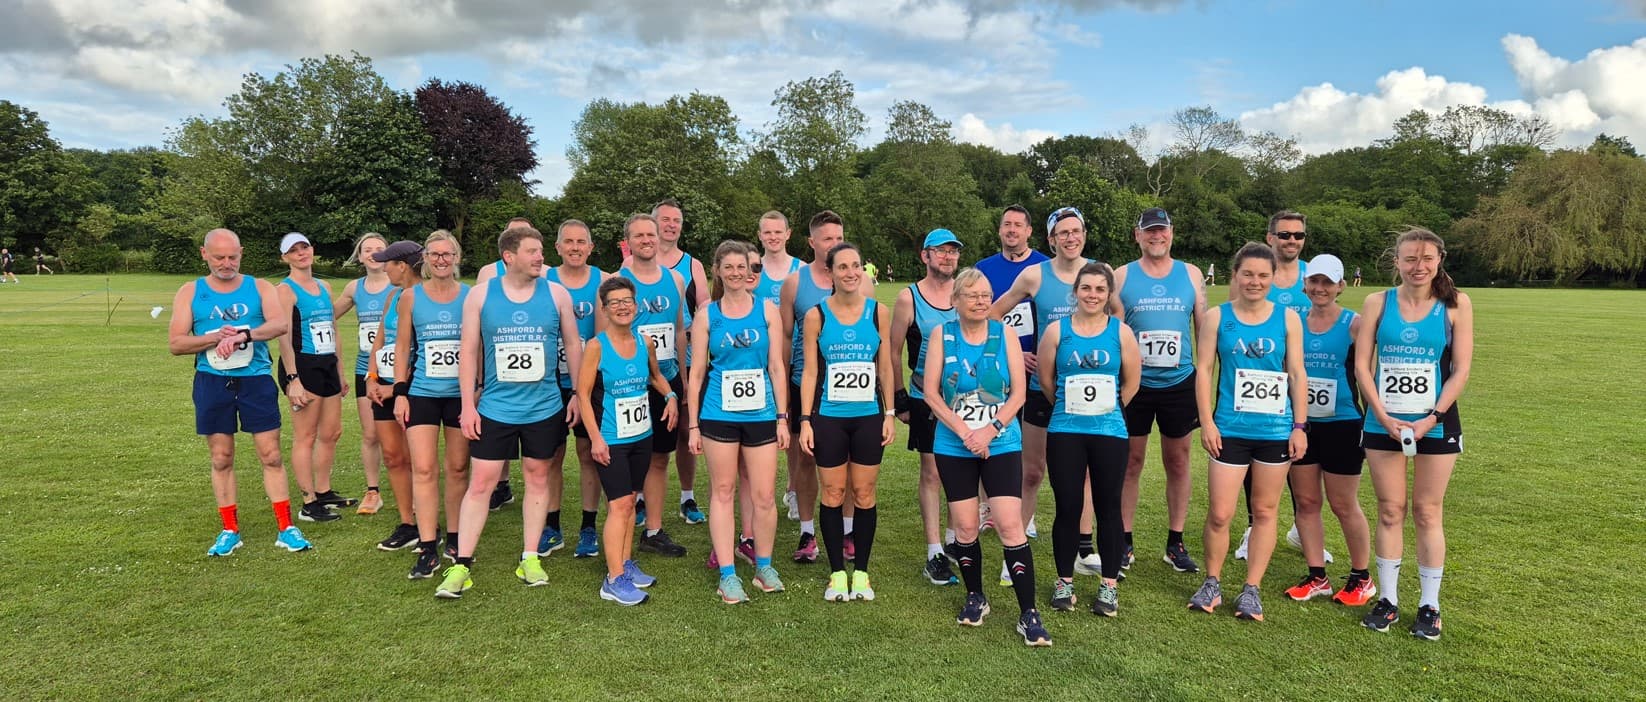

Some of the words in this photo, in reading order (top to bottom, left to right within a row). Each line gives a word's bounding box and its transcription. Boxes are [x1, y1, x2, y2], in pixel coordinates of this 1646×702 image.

[209, 302, 249, 321] A&D
[573, 301, 594, 320] &D
[1133, 304, 1165, 312] DISTRICT
[422, 329, 450, 337] DISTRICT
[493, 334, 527, 342] DISTRICT
[497, 326, 535, 334] ASHFORD
[720, 328, 760, 349] A&D
[828, 343, 865, 351] ASHFORD
[866, 343, 872, 351] &
[1145, 340, 1177, 356] 176
[1232, 337, 1276, 359] A&D
[1382, 344, 1426, 355] ASHFORD
[1427, 347, 1435, 356] &
[507, 353, 533, 370] 28
[1066, 349, 1111, 369] A&D
[614, 376, 644, 387] ASHFORD
[732, 380, 756, 398] 68
[833, 372, 870, 389] 220
[1385, 375, 1429, 394] 288
[1084, 385, 1097, 402] 9
[1241, 380, 1281, 401] 264
[622, 404, 648, 425] 102
[962, 403, 999, 422] 270
